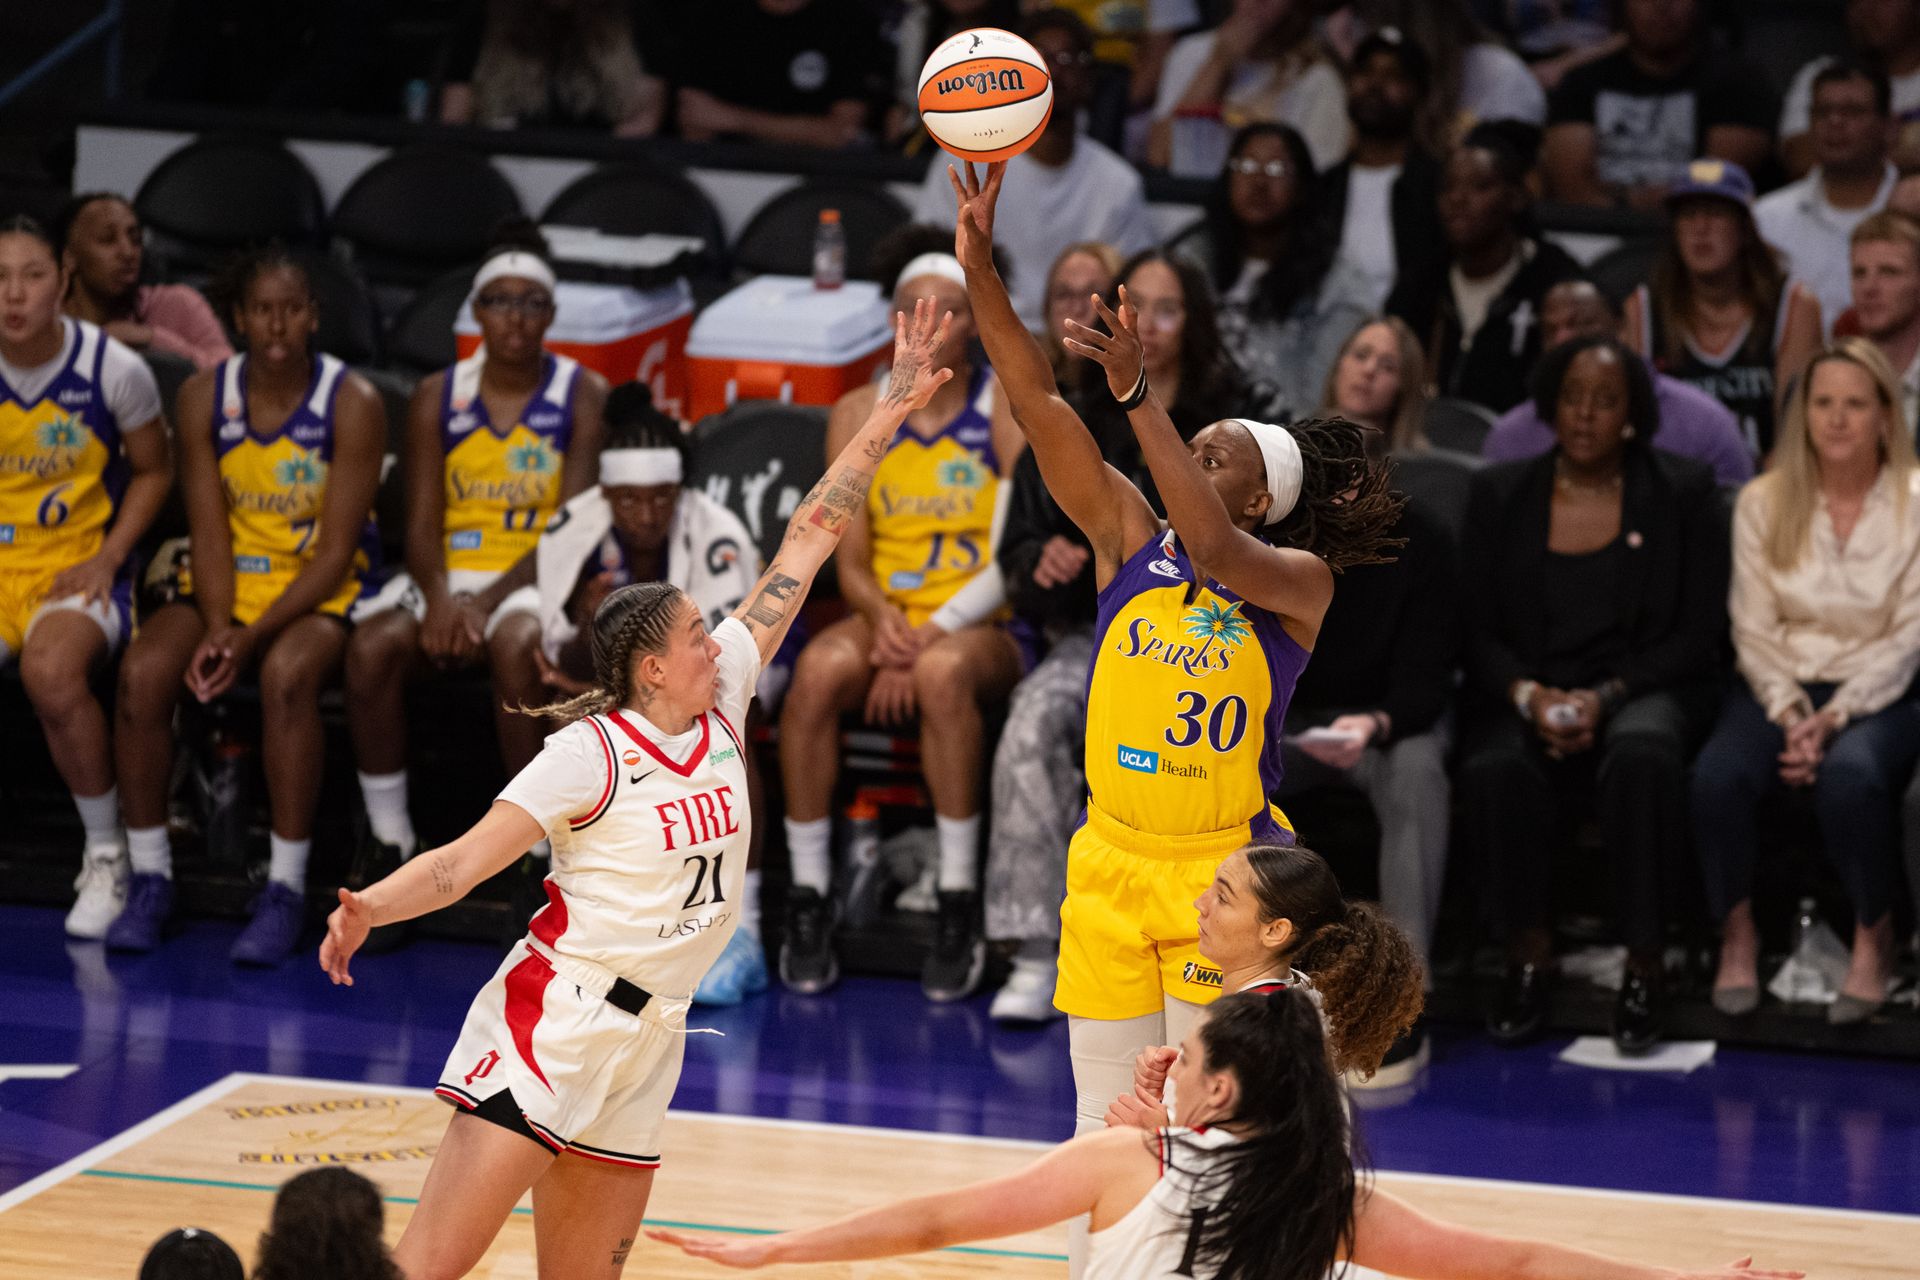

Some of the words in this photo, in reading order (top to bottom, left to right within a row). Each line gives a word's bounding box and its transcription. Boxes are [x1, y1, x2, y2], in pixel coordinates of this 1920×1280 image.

[937, 68, 1025, 95] Wilson
[37, 481, 74, 527] 6
[926, 532, 981, 571] 15
[1155, 558, 1182, 576] NIKE
[1164, 690, 1248, 754] 30
[1120, 750, 1152, 769] UCLA
[1161, 758, 1208, 780] Health
[653, 785, 739, 852] FIRE
[681, 850, 726, 911] 21
[1196, 969, 1224, 986] WN
